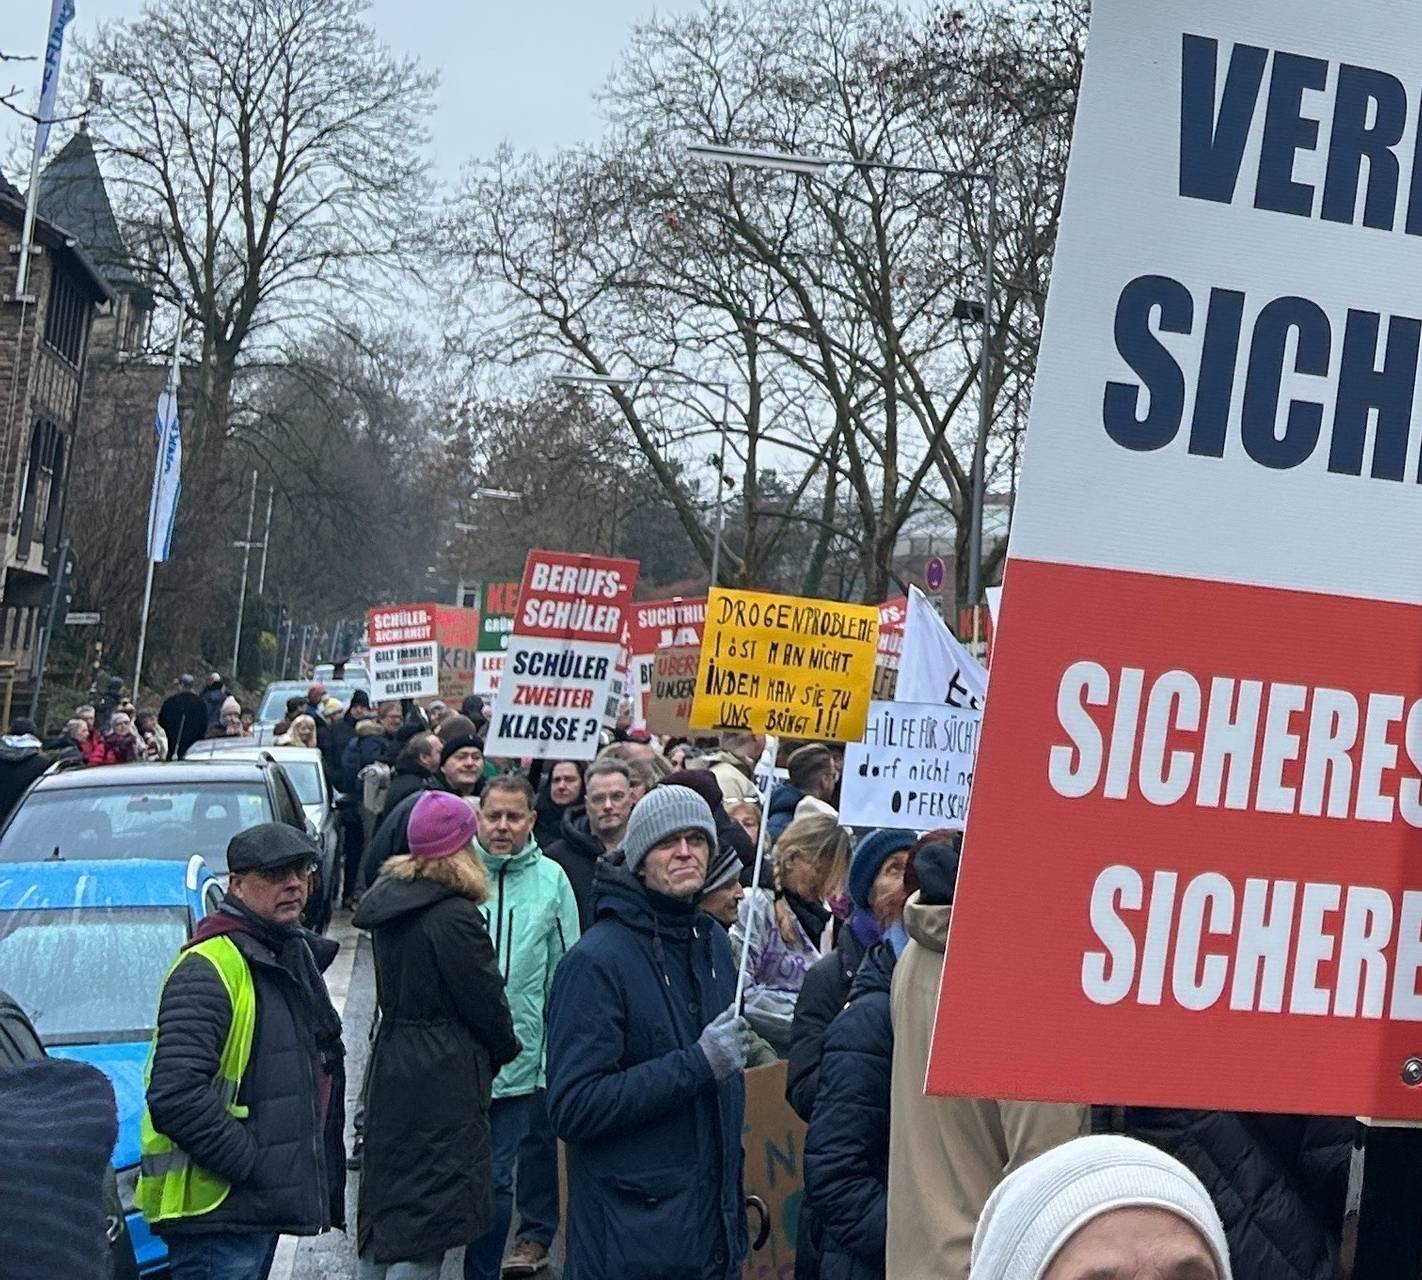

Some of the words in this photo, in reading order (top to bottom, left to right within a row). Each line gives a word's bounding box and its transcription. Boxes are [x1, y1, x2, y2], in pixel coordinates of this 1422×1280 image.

[531, 562, 627, 598] BERUFS-
[374, 610, 431, 629] SCHÜLER-
[523, 598, 621, 633] SCHÜLER
[717, 596, 878, 643] DROGENPROBLEME
[657, 627, 700, 648] JA
[513, 650, 609, 680] SCHÜLER
[768, 640, 805, 667] MAN
[514, 685, 594, 708] ZWEITER
[767, 677, 796, 703] MAN
[831, 688, 851, 711] ZU
[720, 701, 752, 727] UNS
[919, 716, 937, 749] FÜR
[909, 758, 949, 783] nicht
